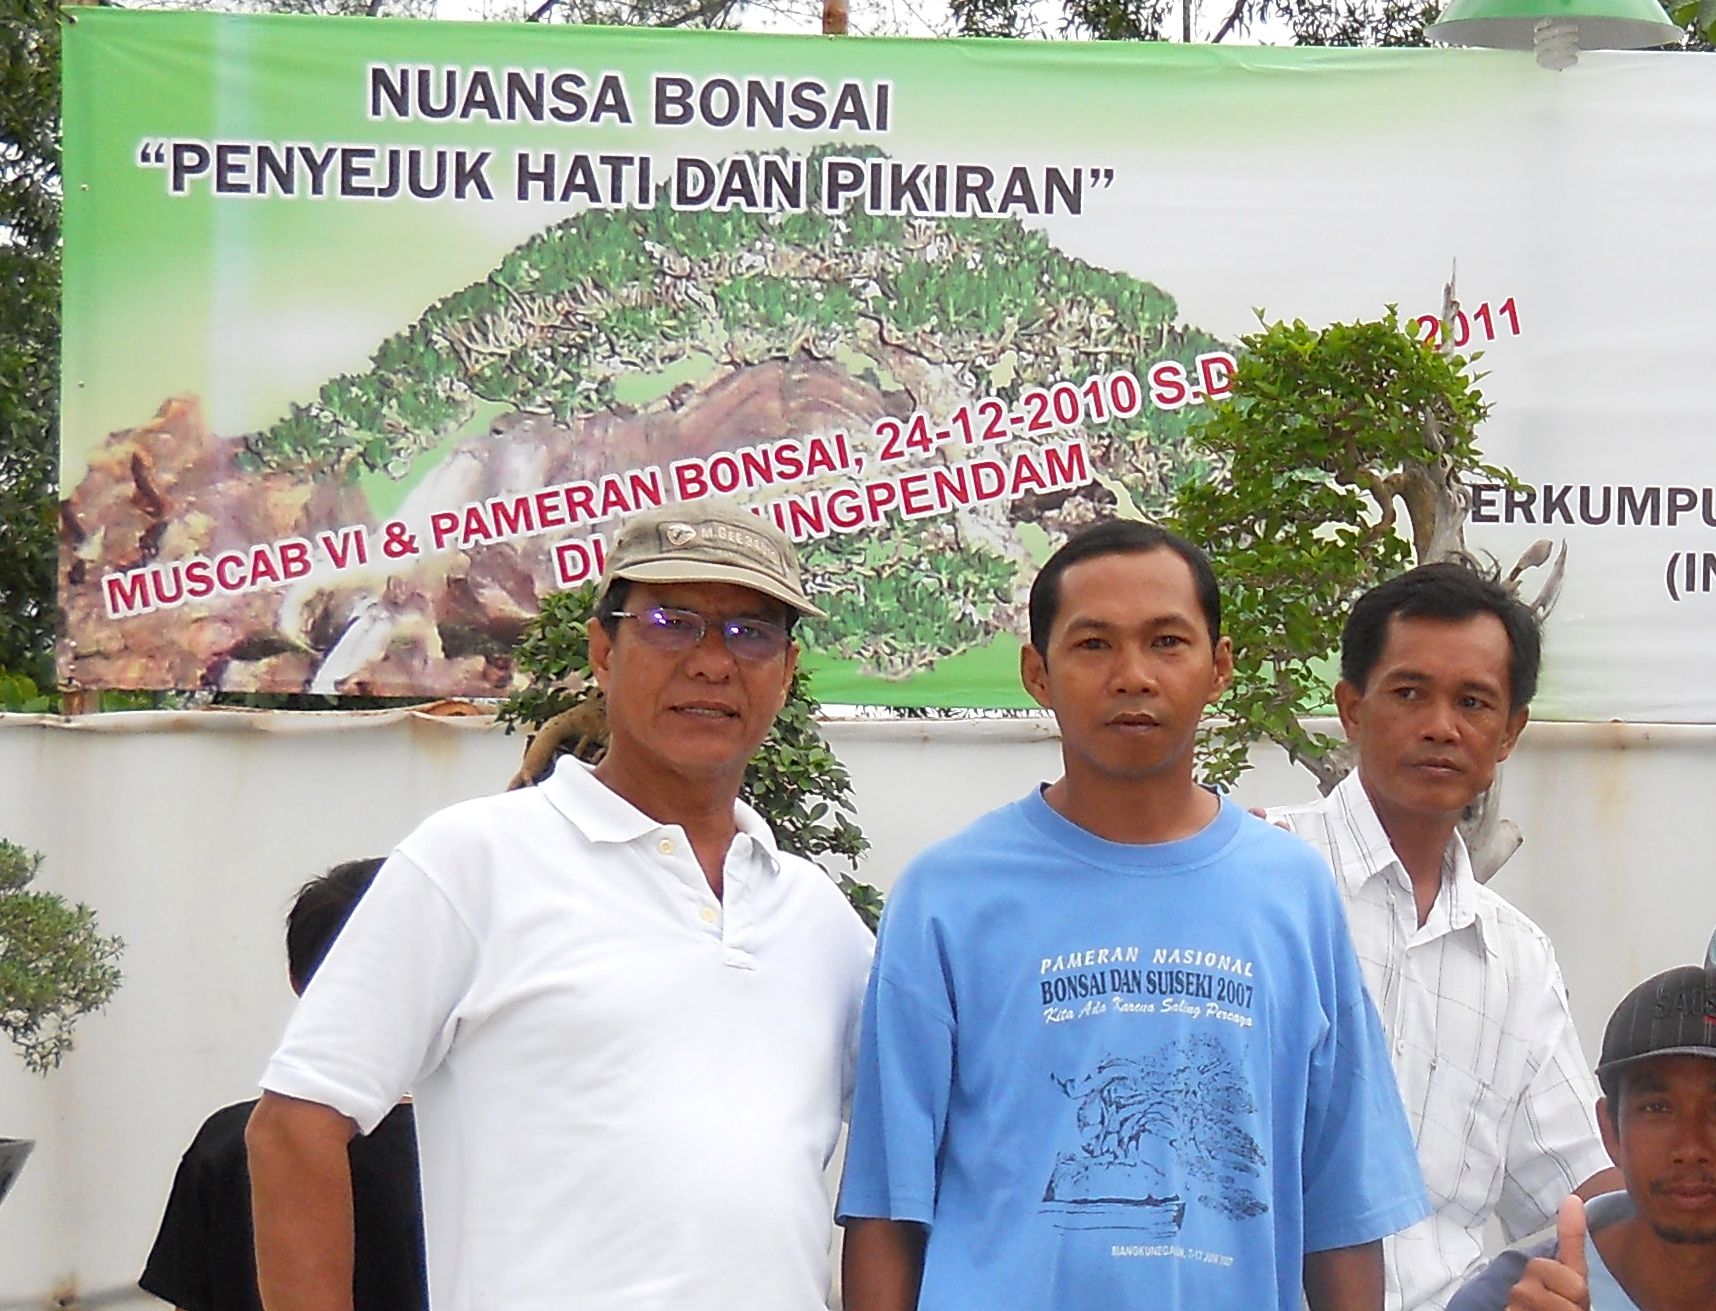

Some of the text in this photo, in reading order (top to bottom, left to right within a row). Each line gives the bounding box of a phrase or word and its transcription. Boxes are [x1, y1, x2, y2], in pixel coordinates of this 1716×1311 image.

[371, 67, 888, 132] NUANSA BONSAI
[517, 153, 650, 204] HATI
[676, 158, 802, 209] DAN
[107, 543, 309, 612] MUSCAB
[323, 531, 366, 568] VI
[383, 523, 416, 558] &
[431, 472, 661, 548] PAMERAN
[675, 434, 866, 500] BONSAI,
[876, 376, 1136, 461] 24-12-2010
[1040, 946, 1254, 977] PAMERAN NASIONAL
[1040, 968, 1254, 1009] BONSAI DAN SUISEKI 2007
[1043, 1006, 1075, 1025] Kita
[1078, 1000, 1108, 1019] Ada
